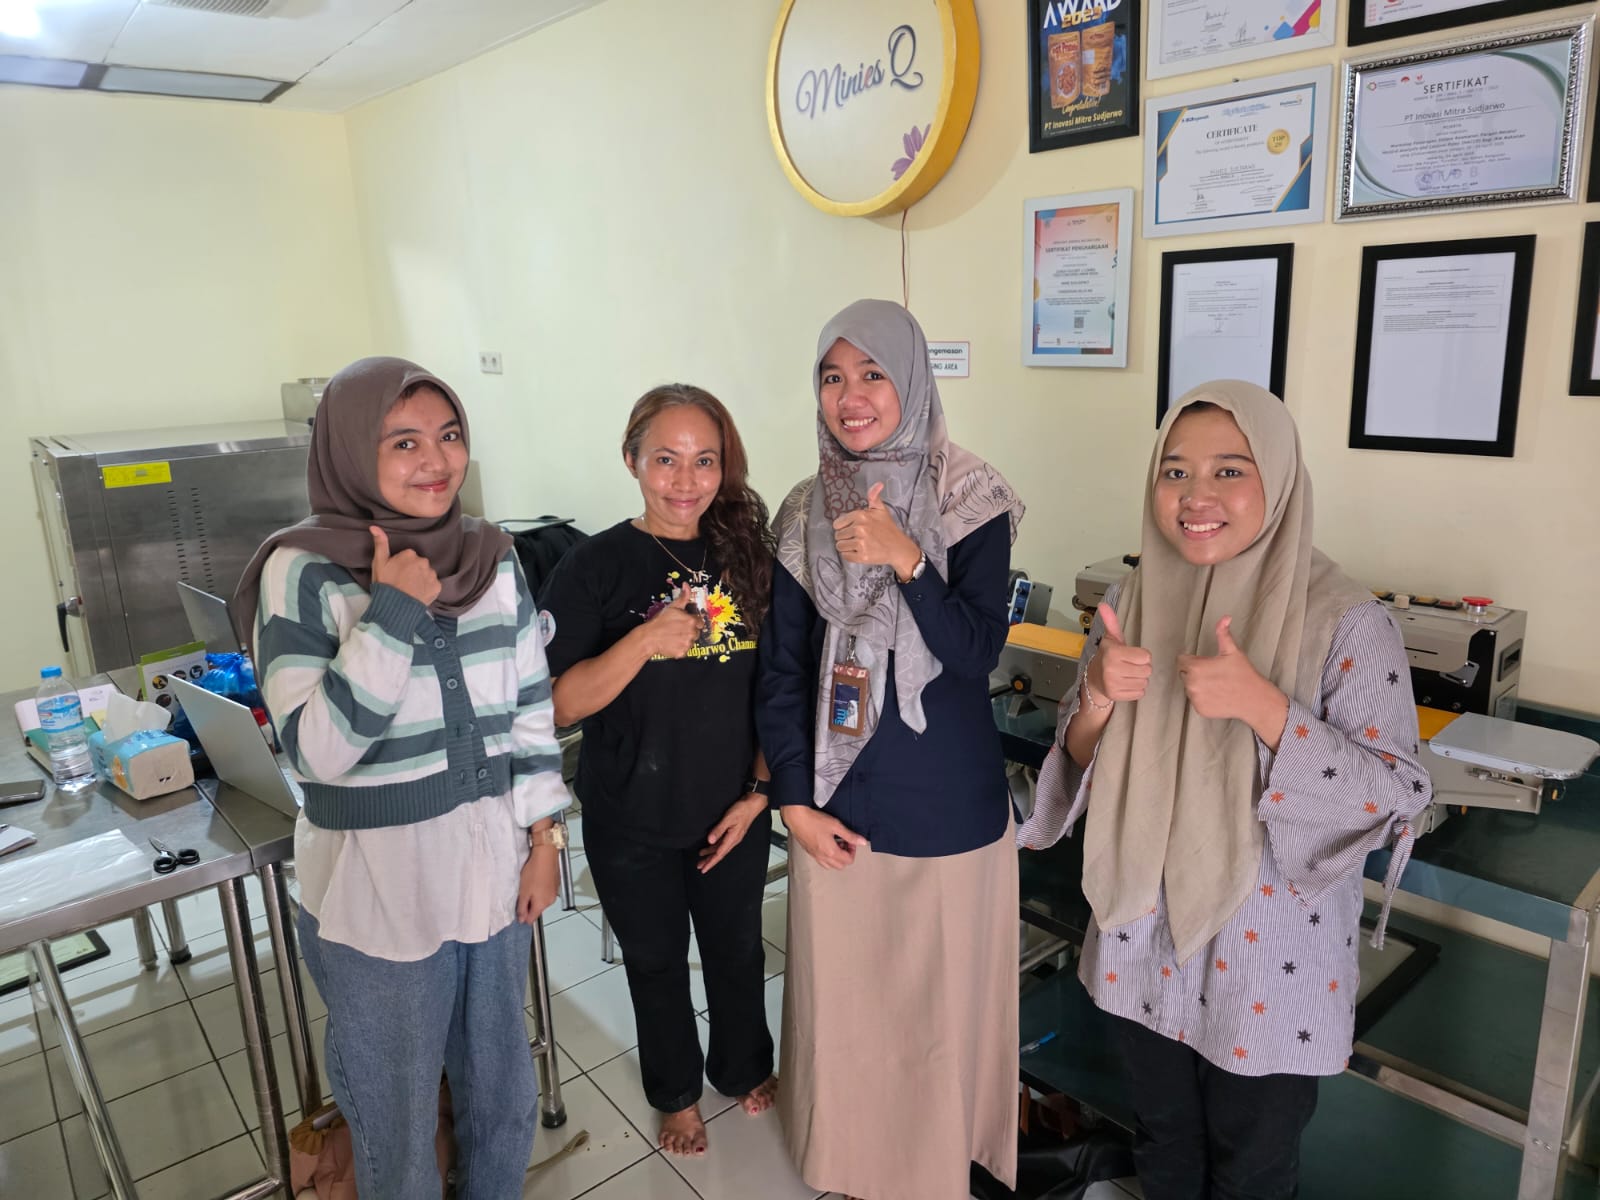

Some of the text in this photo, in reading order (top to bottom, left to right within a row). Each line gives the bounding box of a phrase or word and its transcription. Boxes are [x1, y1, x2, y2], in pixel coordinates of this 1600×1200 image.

[796, 24, 923, 119] Minies Q
[1423, 75, 1489, 95] SERTIFIKAT
[1044, 121, 1052, 131] PT
[1053, 117, 1074, 129] Inovasi
[1075, 115, 1092, 125] Mitra
[1093, 110, 1123, 122] Sudjarwo
[1415, 111, 1442, 121] Inovasi
[1444, 107, 1466, 117] Mitra
[1468, 102, 1506, 113] Sudjarwo
[1206, 124, 1258, 140] CERTIFICATE
[687, 643, 726, 658] udjarwo
